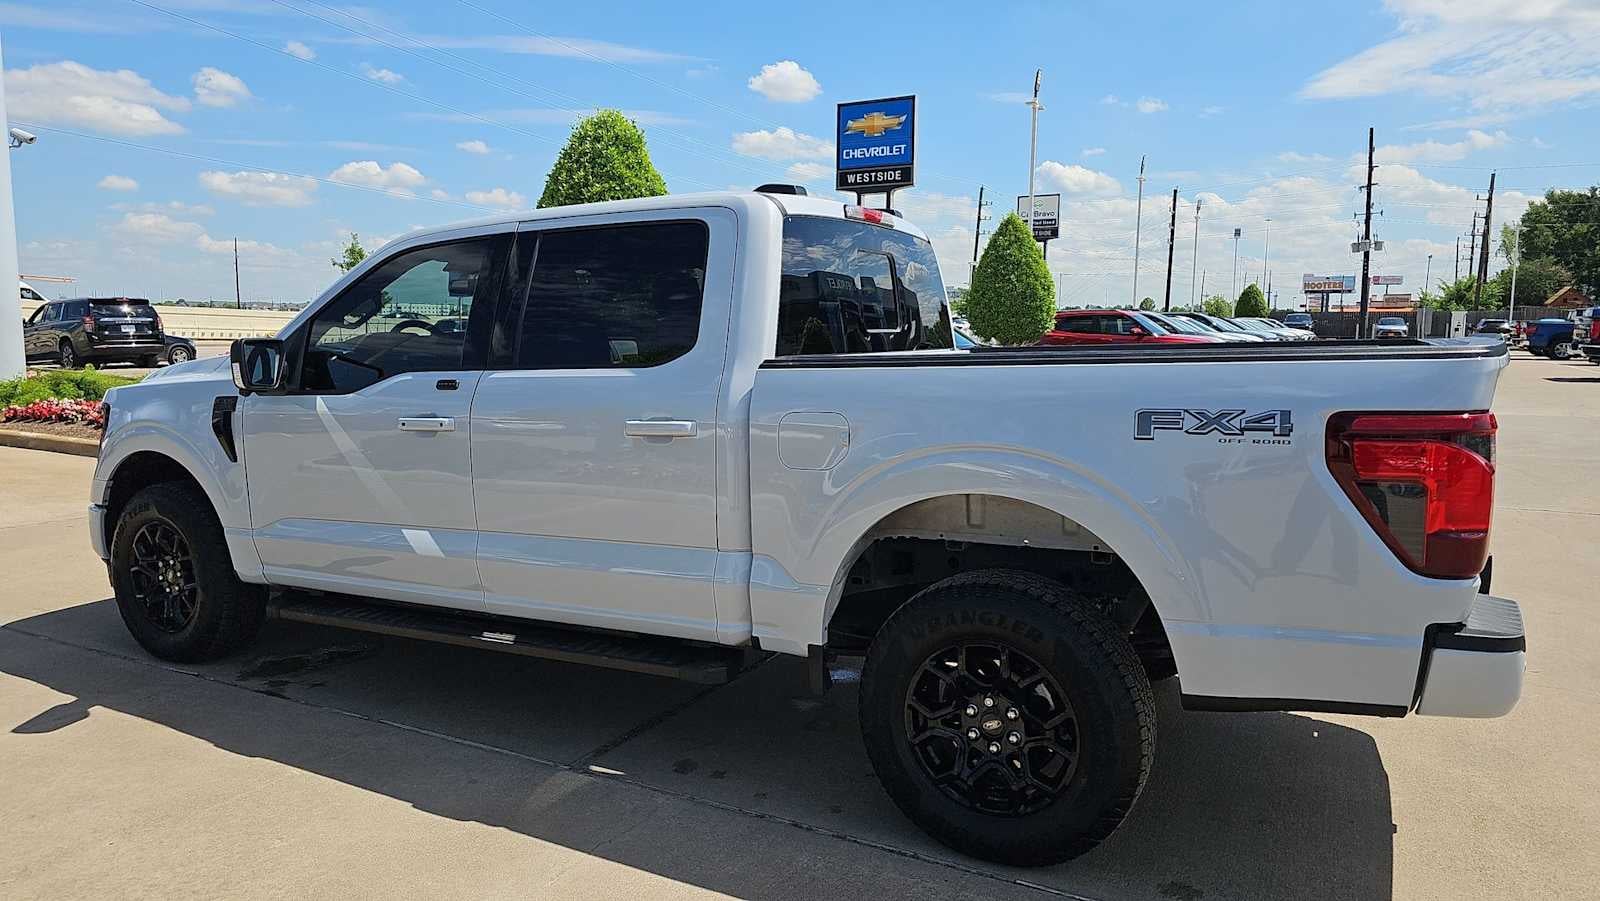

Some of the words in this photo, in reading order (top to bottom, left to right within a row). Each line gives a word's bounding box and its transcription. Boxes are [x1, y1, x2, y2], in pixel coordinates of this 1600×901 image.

[843, 145, 906, 159] CHEVROLET
[847, 171, 901, 183] WESTSIDE
[1304, 281, 1343, 290] HOOTERS
[1134, 408, 1293, 440] FX4
[911, 608, 1043, 643] WRANGLER
